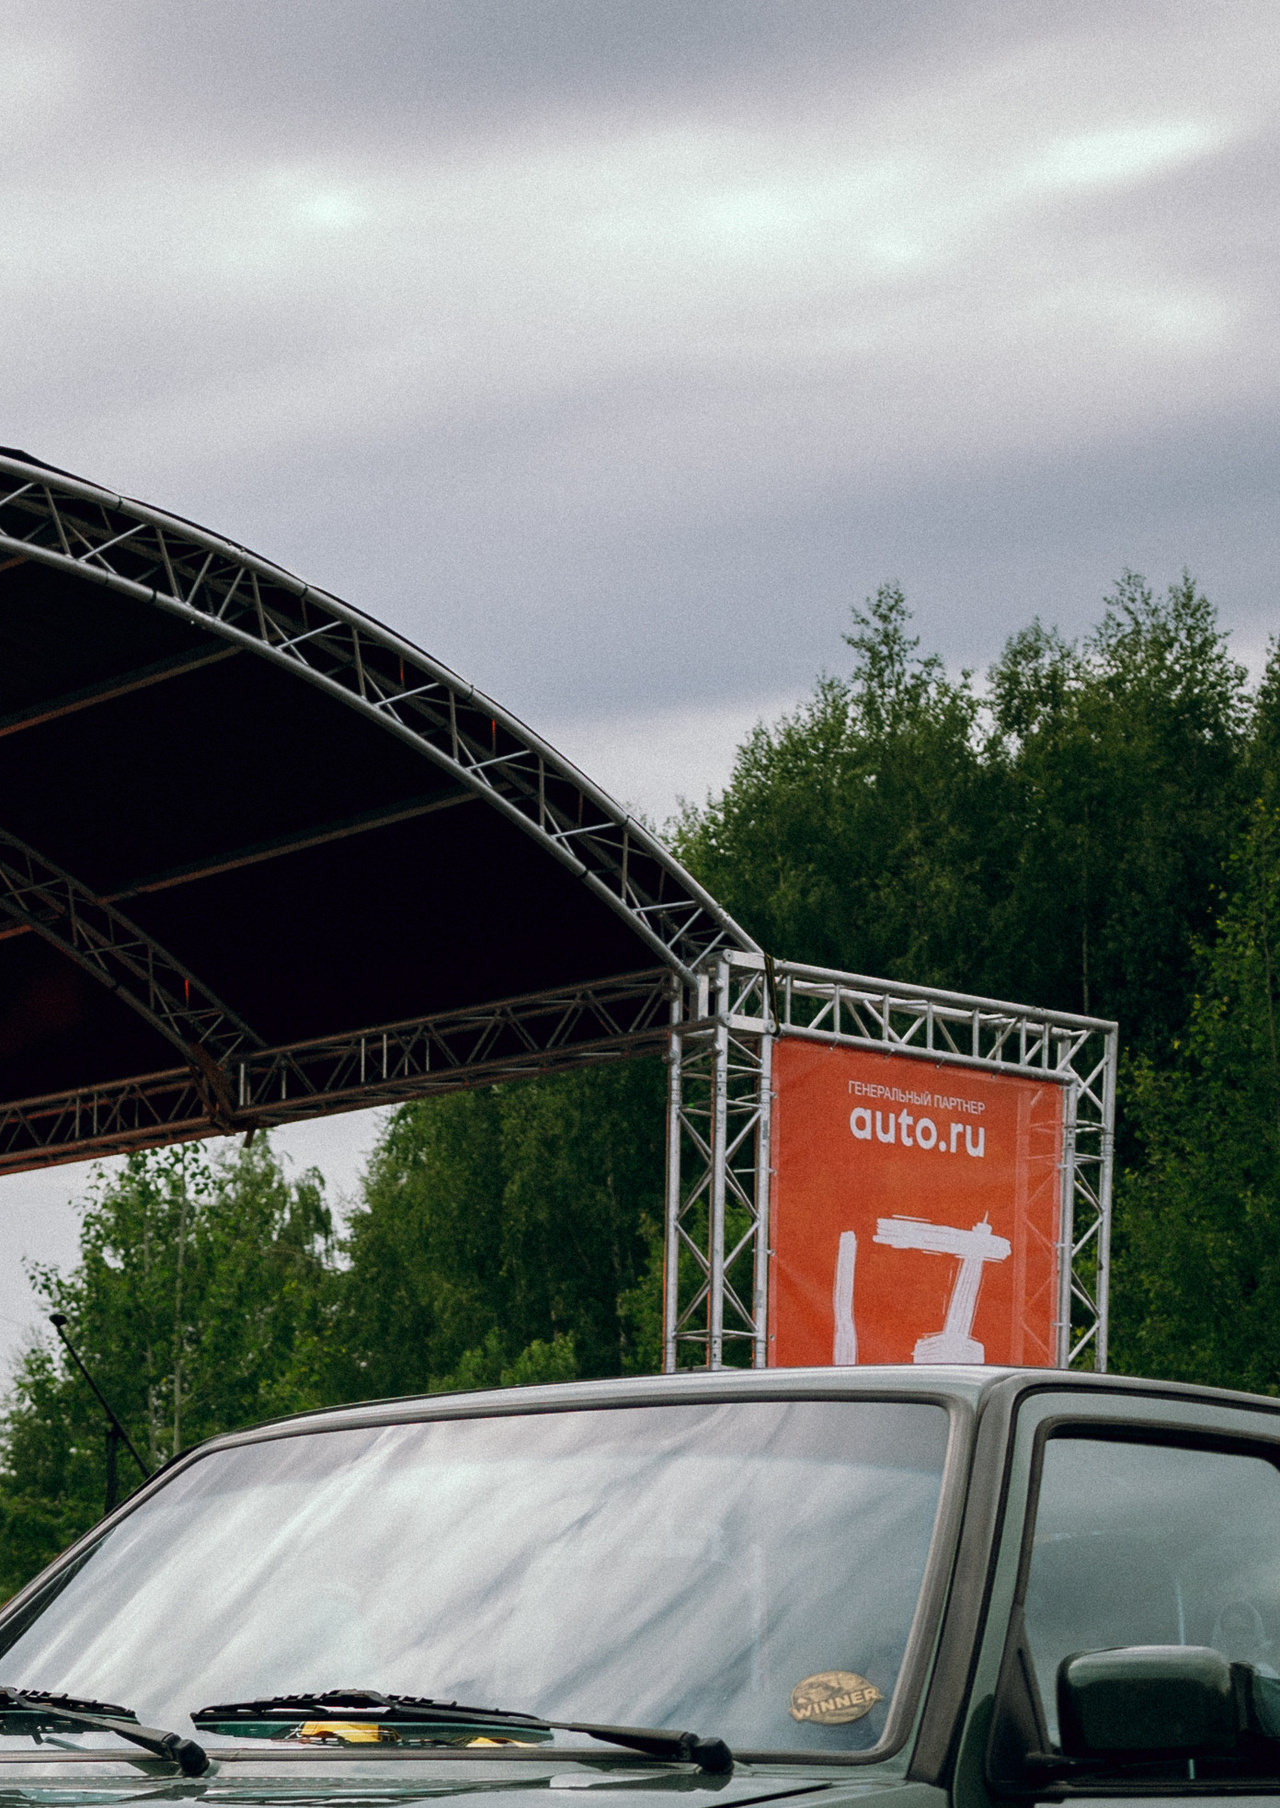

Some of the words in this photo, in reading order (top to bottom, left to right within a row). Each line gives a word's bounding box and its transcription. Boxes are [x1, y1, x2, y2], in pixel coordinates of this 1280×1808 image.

[848, 1079, 932, 1107] ГЕНЕРАЛЬНЫЙ
[933, 1094, 986, 1115] ПАРТНЕР
[849, 1106, 986, 1158] auto.ru
[792, 1687, 879, 1719] WINNER
